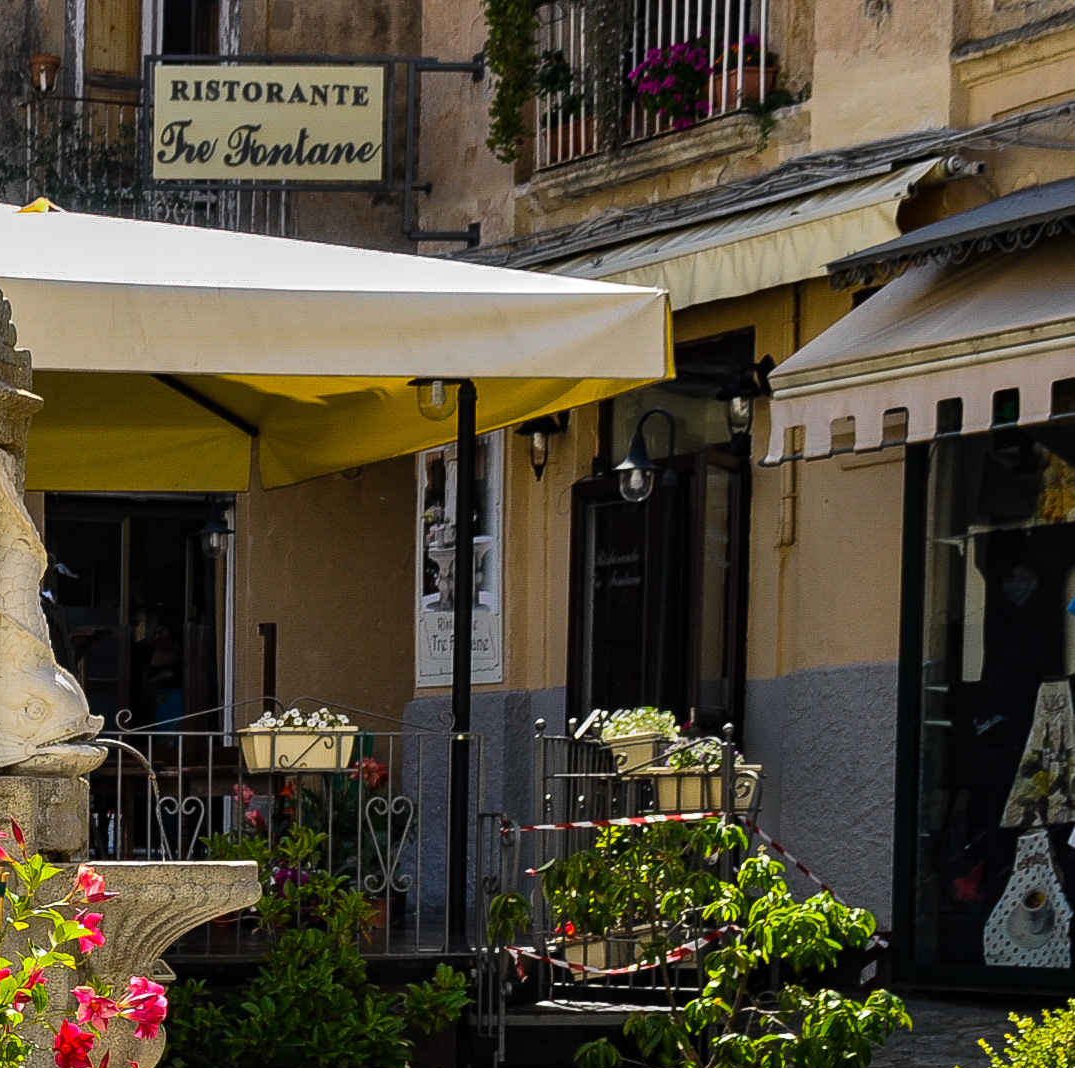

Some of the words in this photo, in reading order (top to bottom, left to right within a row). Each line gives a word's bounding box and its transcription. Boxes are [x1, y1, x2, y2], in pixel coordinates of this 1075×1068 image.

[169, 79, 370, 107] RISTORANTE
[156, 119, 219, 165] Tre
[224, 123, 382, 167] Fontane
[432, 634, 447, 652] Tre
